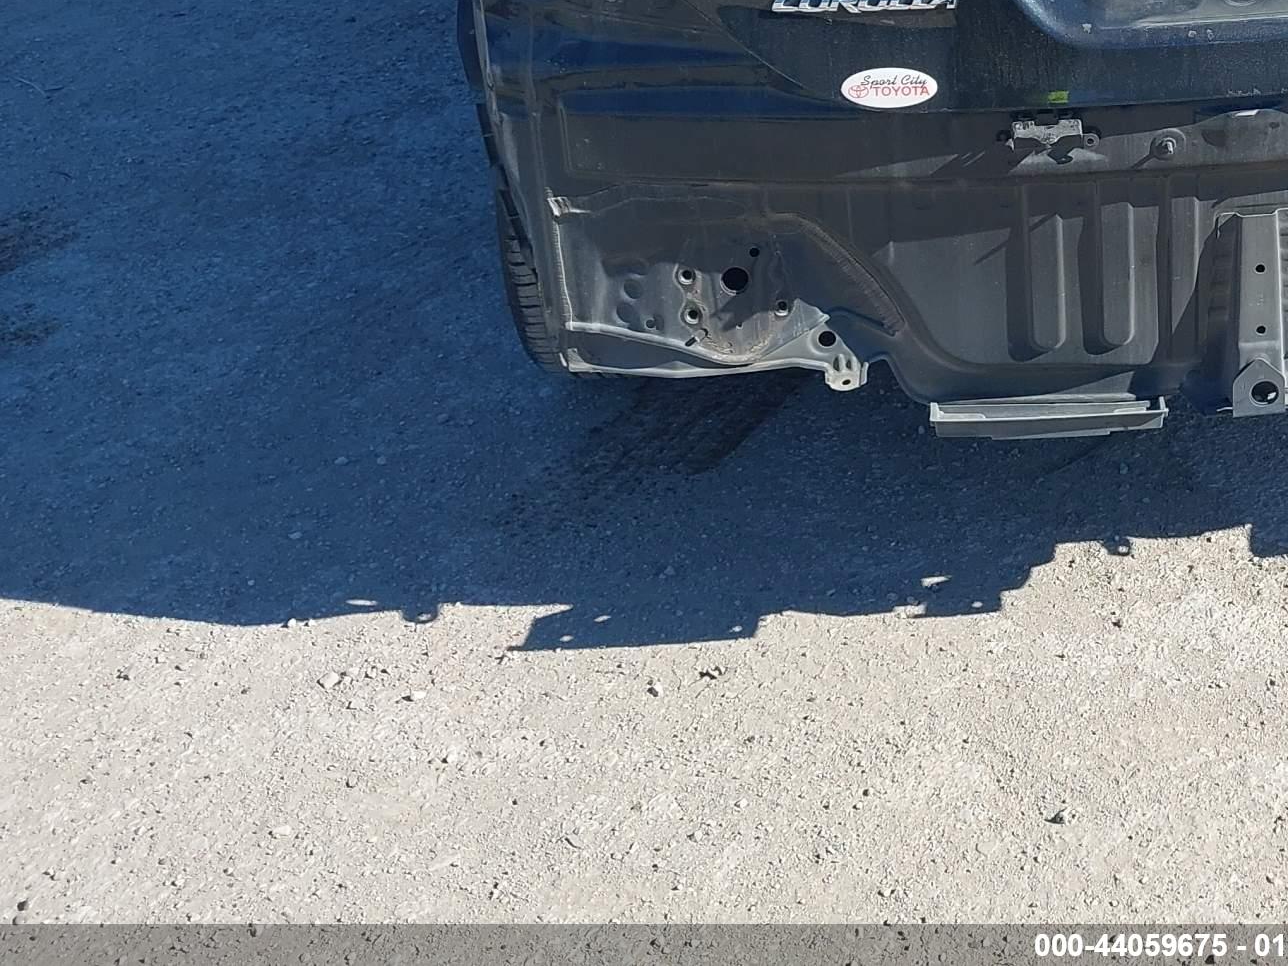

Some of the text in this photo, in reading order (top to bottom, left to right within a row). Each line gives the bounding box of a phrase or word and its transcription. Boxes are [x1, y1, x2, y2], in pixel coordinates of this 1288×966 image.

[860, 75, 928, 89] Sport City
[873, 85, 929, 98] TOYOTA
